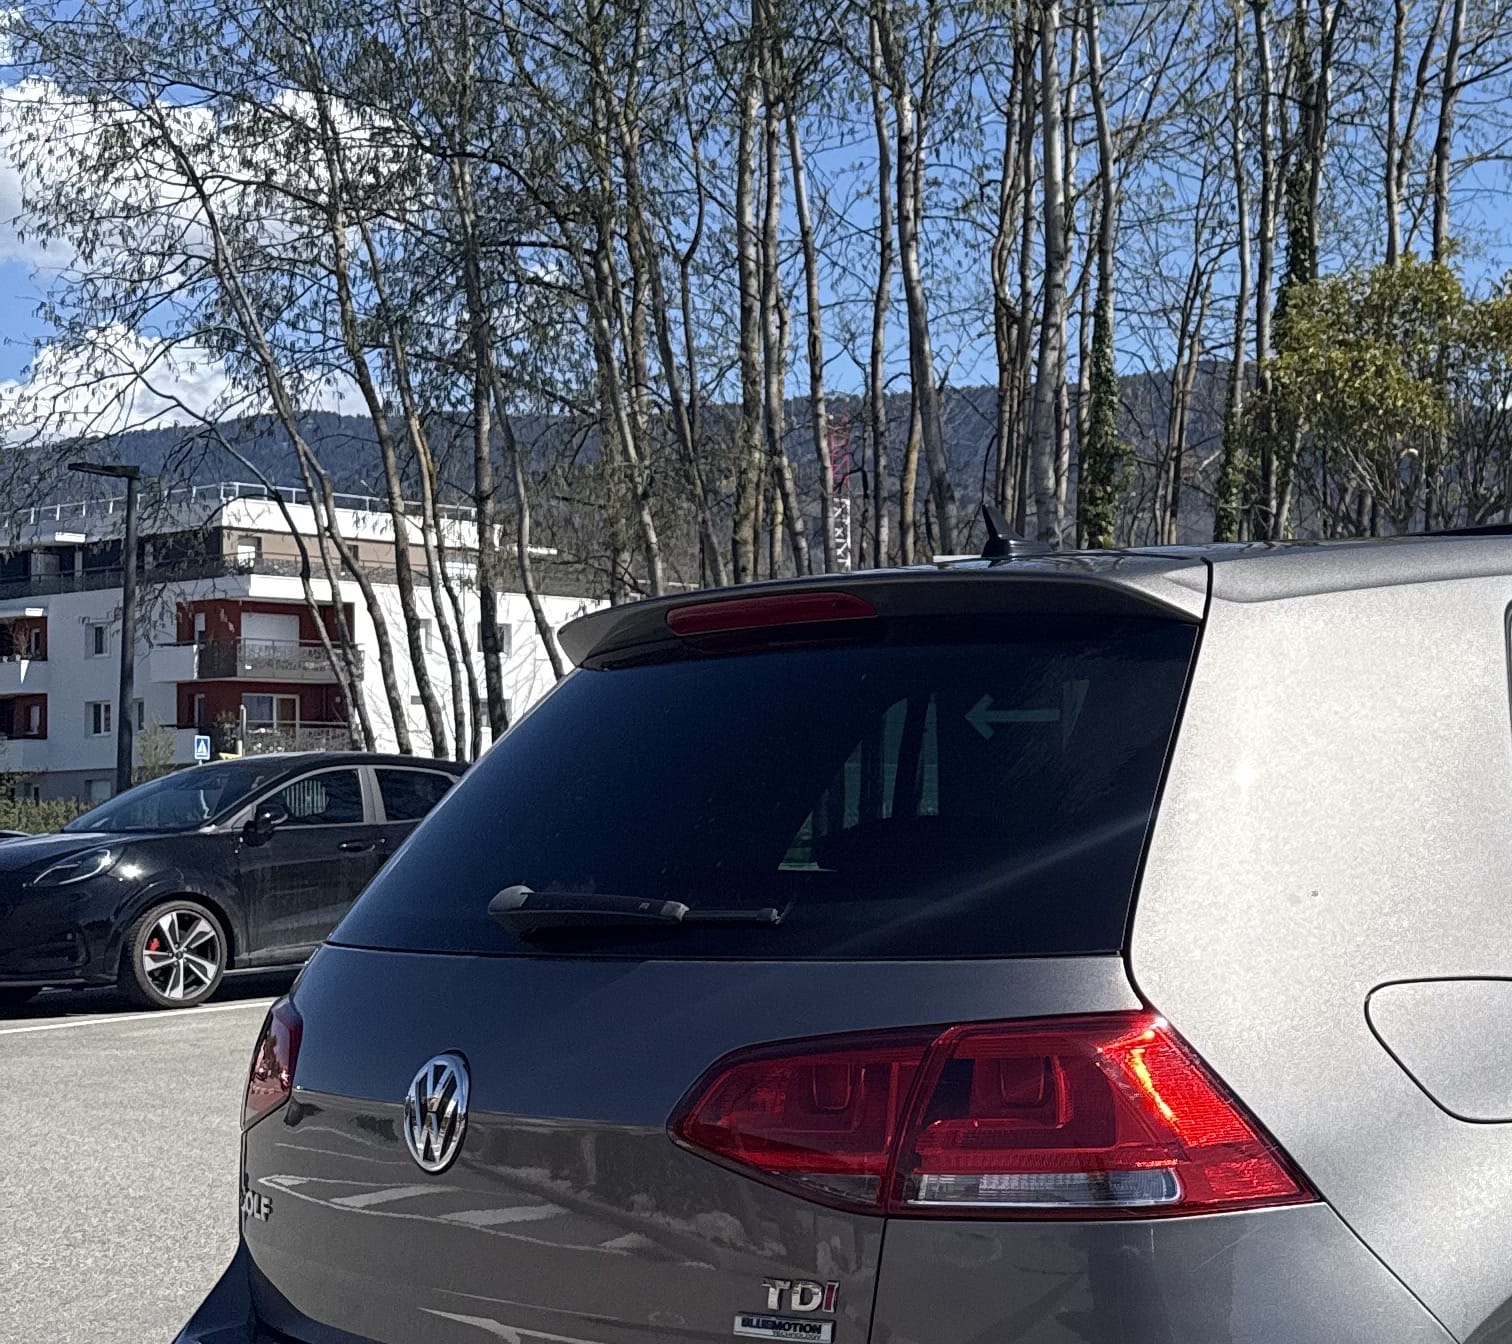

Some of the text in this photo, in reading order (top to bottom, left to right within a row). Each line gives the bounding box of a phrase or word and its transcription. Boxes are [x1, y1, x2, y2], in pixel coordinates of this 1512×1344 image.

[241, 1190, 273, 1222] OLF
[760, 1277, 840, 1313] TDI
[741, 1317, 822, 1334] BLUEMOTION
